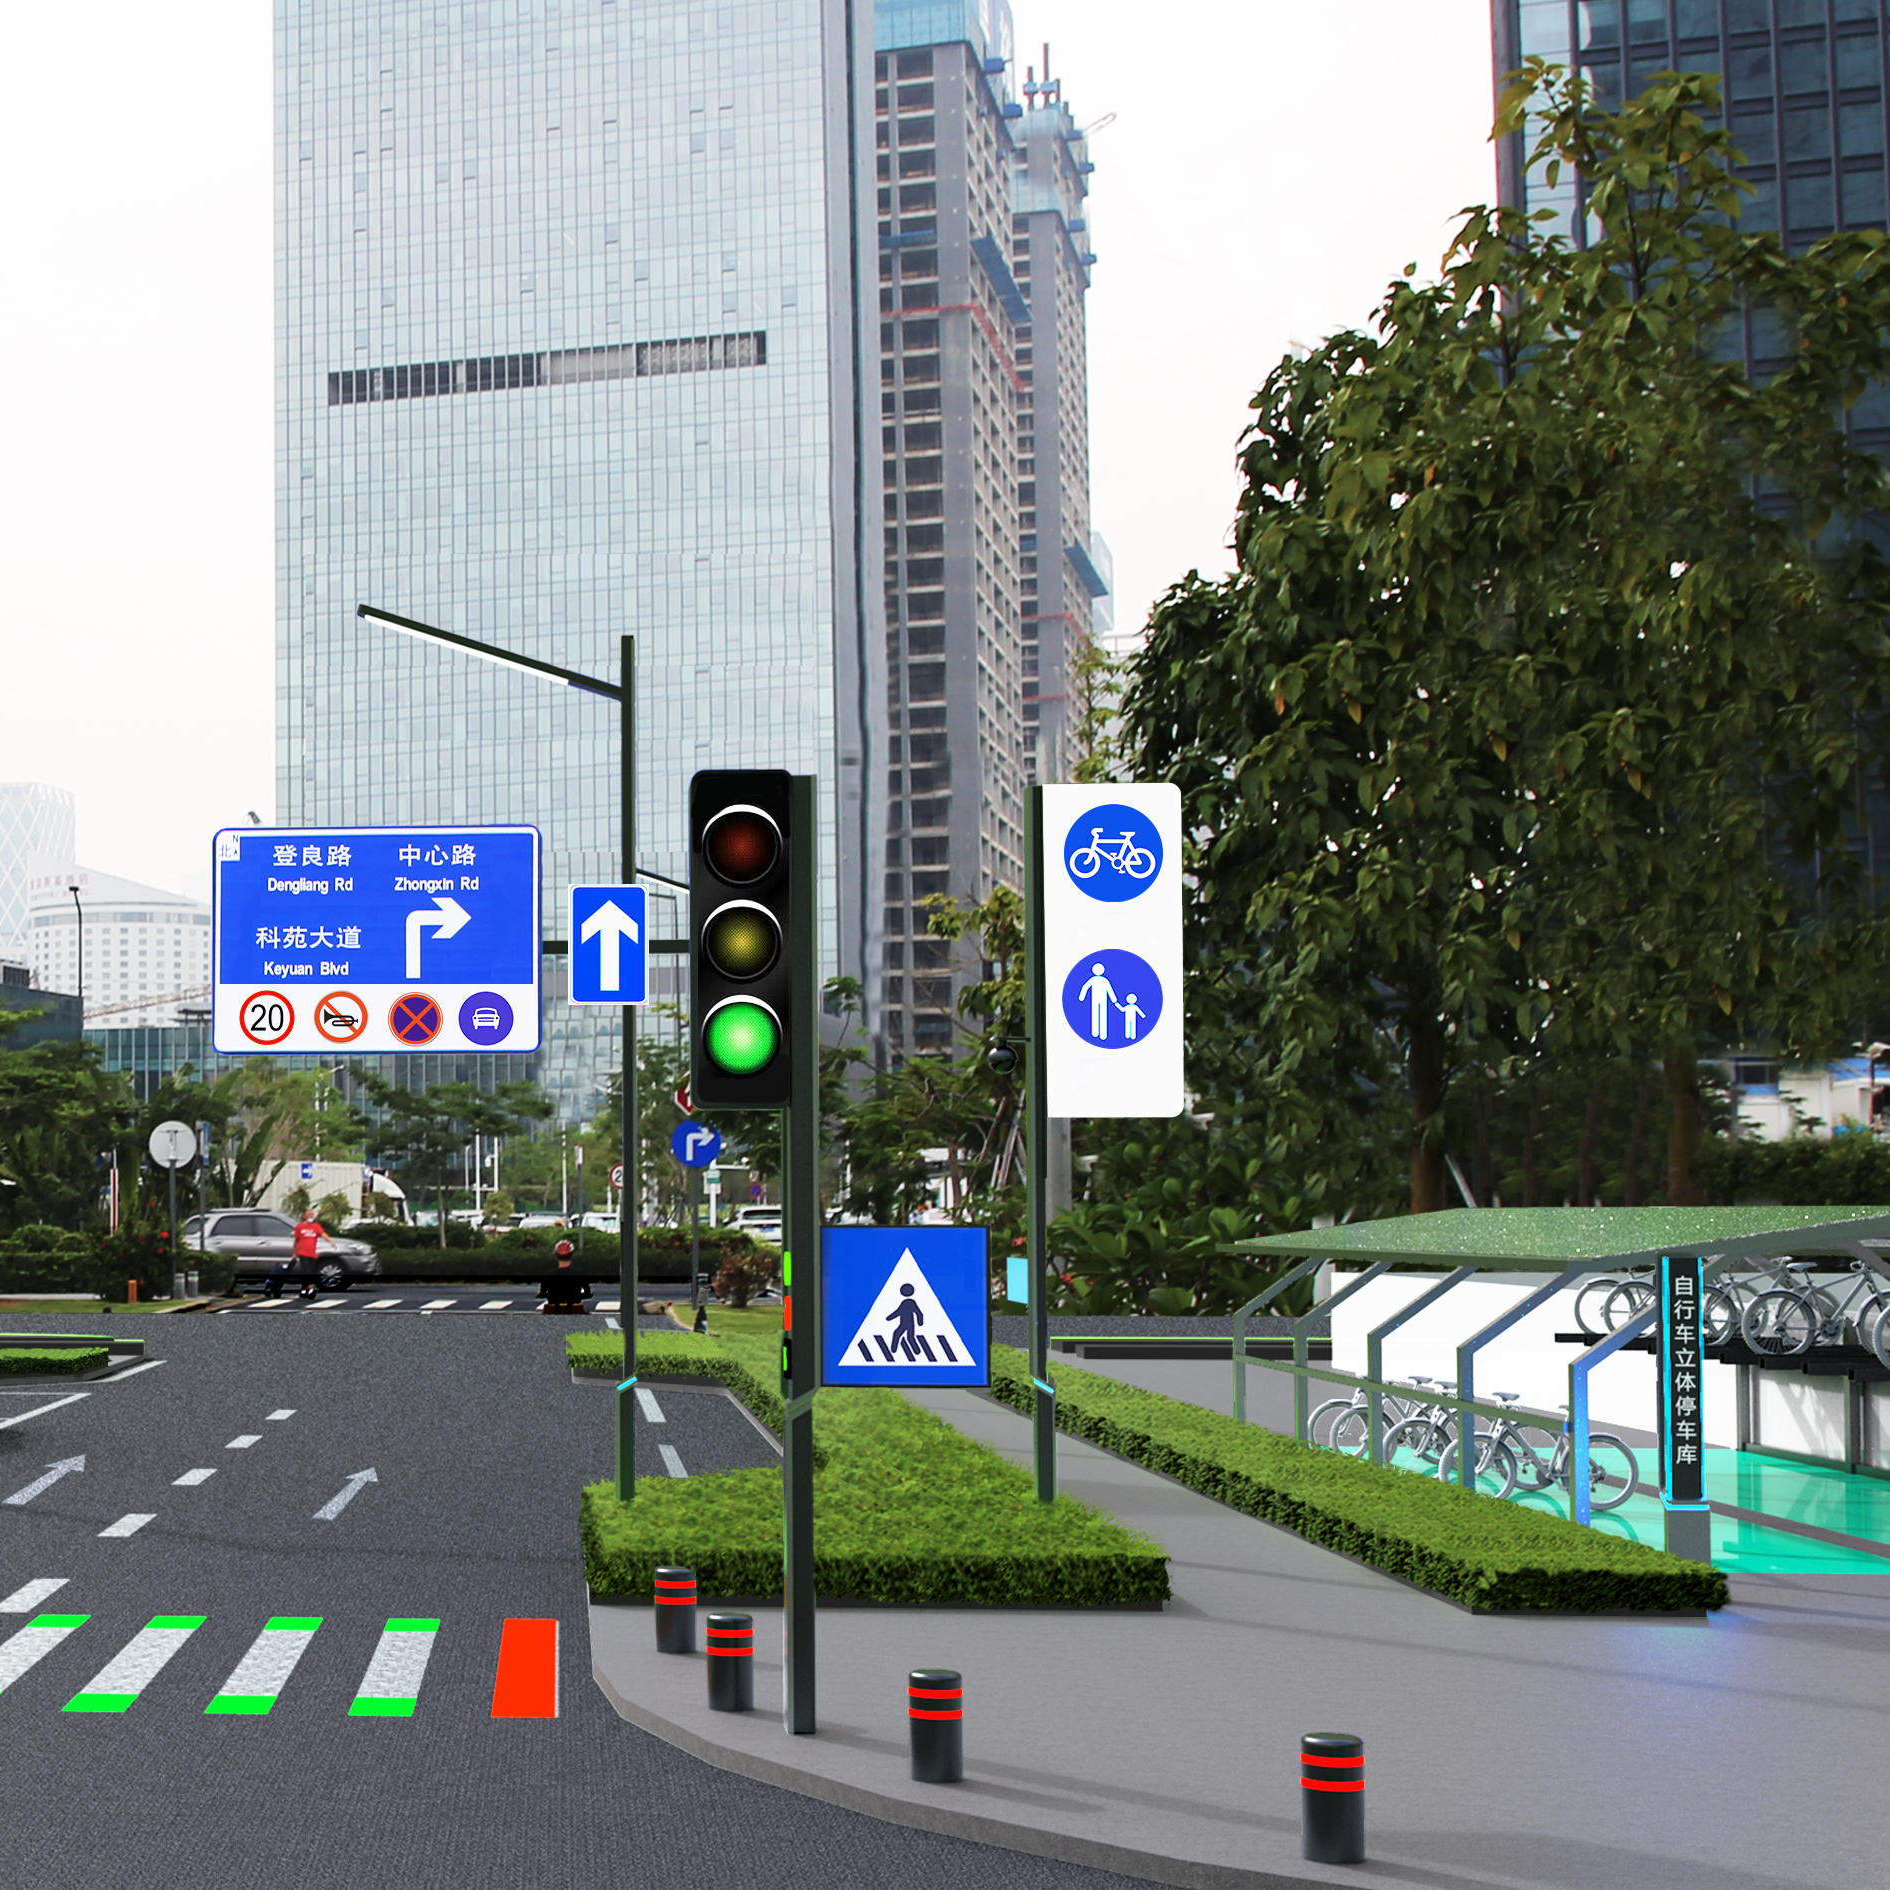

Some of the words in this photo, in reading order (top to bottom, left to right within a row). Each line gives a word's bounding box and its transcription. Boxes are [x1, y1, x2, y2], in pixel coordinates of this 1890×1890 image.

[232, 834, 239, 843] N
[219, 844, 231, 857] 北
[273, 844, 352, 867] 登良路
[398, 844, 477, 867] 中心路
[267, 876, 329, 895] Dengliang
[334, 876, 354, 892] Rd
[394, 876, 455, 894] Zhongxin
[460, 876, 480, 891] Rd
[255, 925, 362, 949] 科苑大道
[263, 961, 313, 979] Keyuan
[320, 961, 349, 976] Blvd
[250, 1003, 285, 1032] 20
[615, 1169, 623, 1183] 2
[1673, 1275, 1698, 1465] 自行车立体停车库
